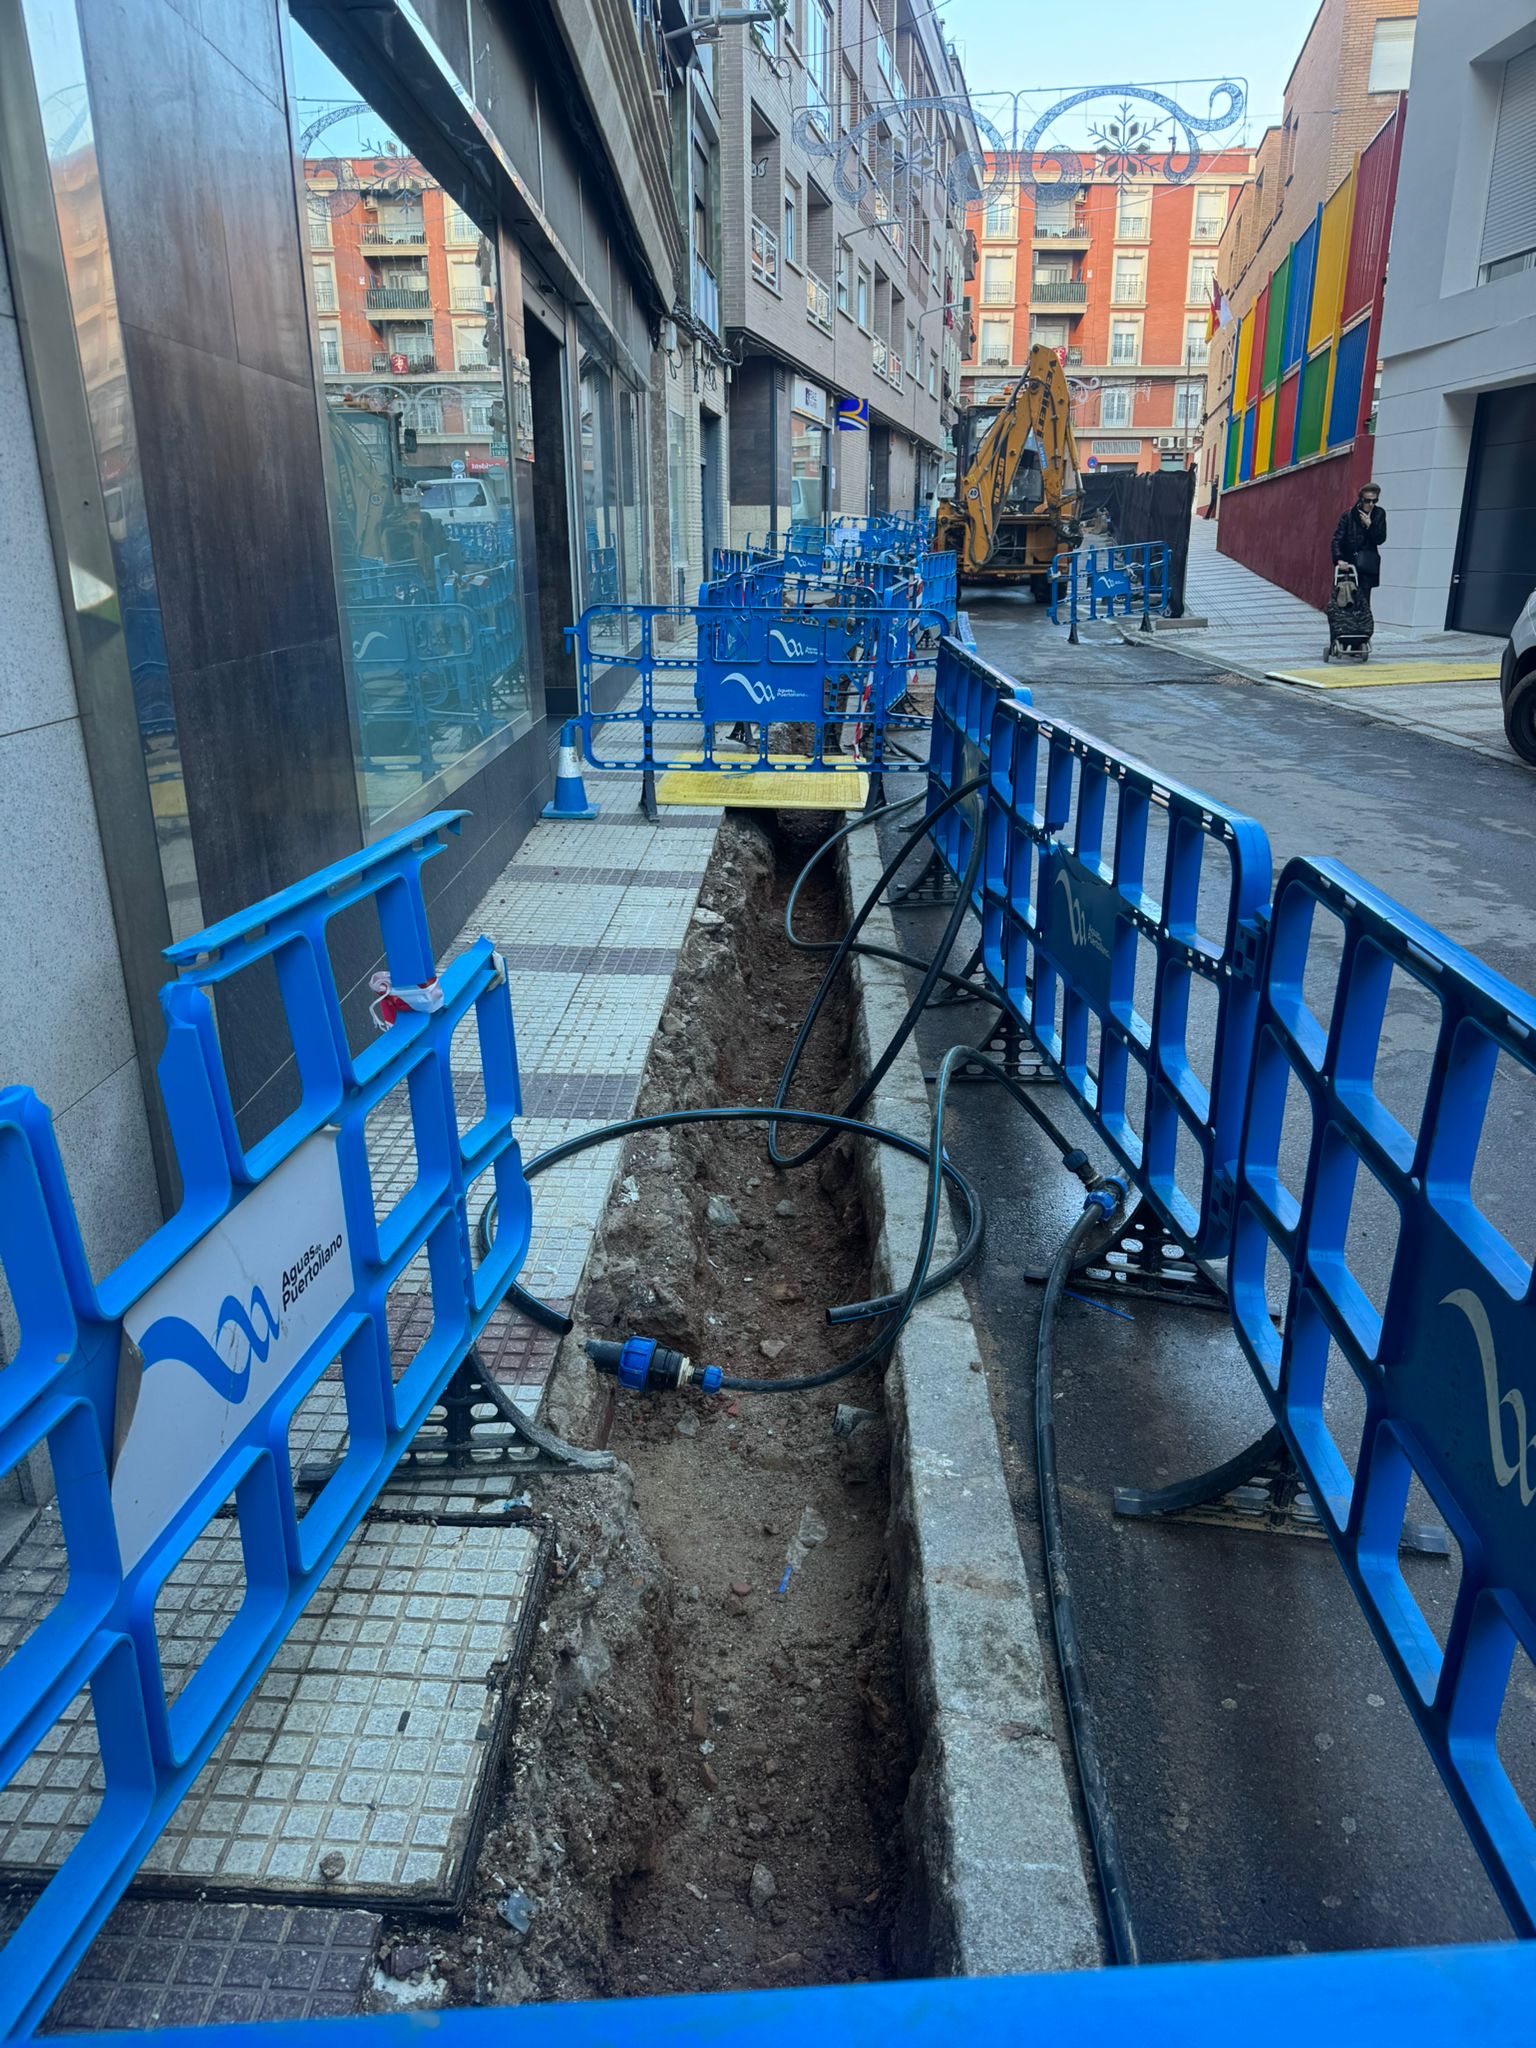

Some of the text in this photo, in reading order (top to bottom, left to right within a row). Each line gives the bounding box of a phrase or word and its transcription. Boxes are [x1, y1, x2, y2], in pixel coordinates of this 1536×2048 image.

[282, 1244, 322, 1293] Aguas de
[282, 1234, 342, 1312] Puertollano
